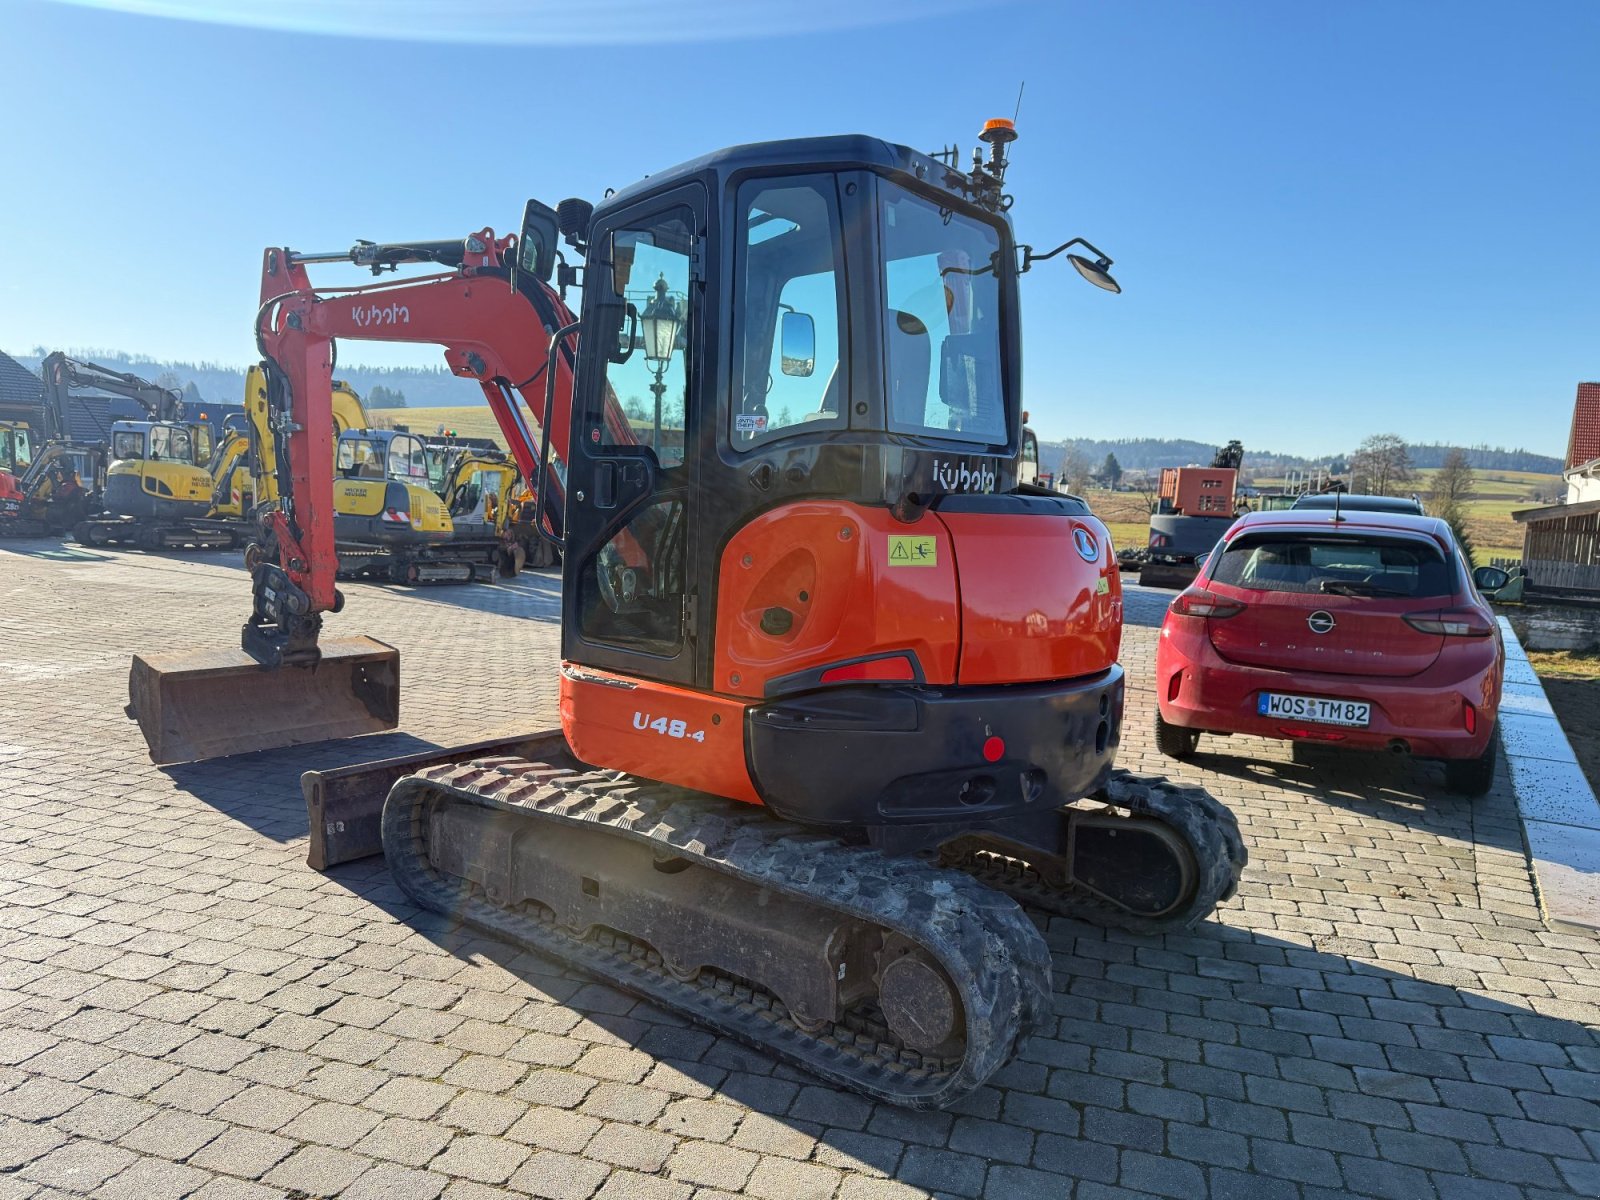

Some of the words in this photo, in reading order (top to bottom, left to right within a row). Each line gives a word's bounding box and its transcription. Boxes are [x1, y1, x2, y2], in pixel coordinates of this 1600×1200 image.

[352, 302, 410, 327] Kubota
[932, 459, 995, 492] Kubota
[1270, 695, 1305, 714] WOS
